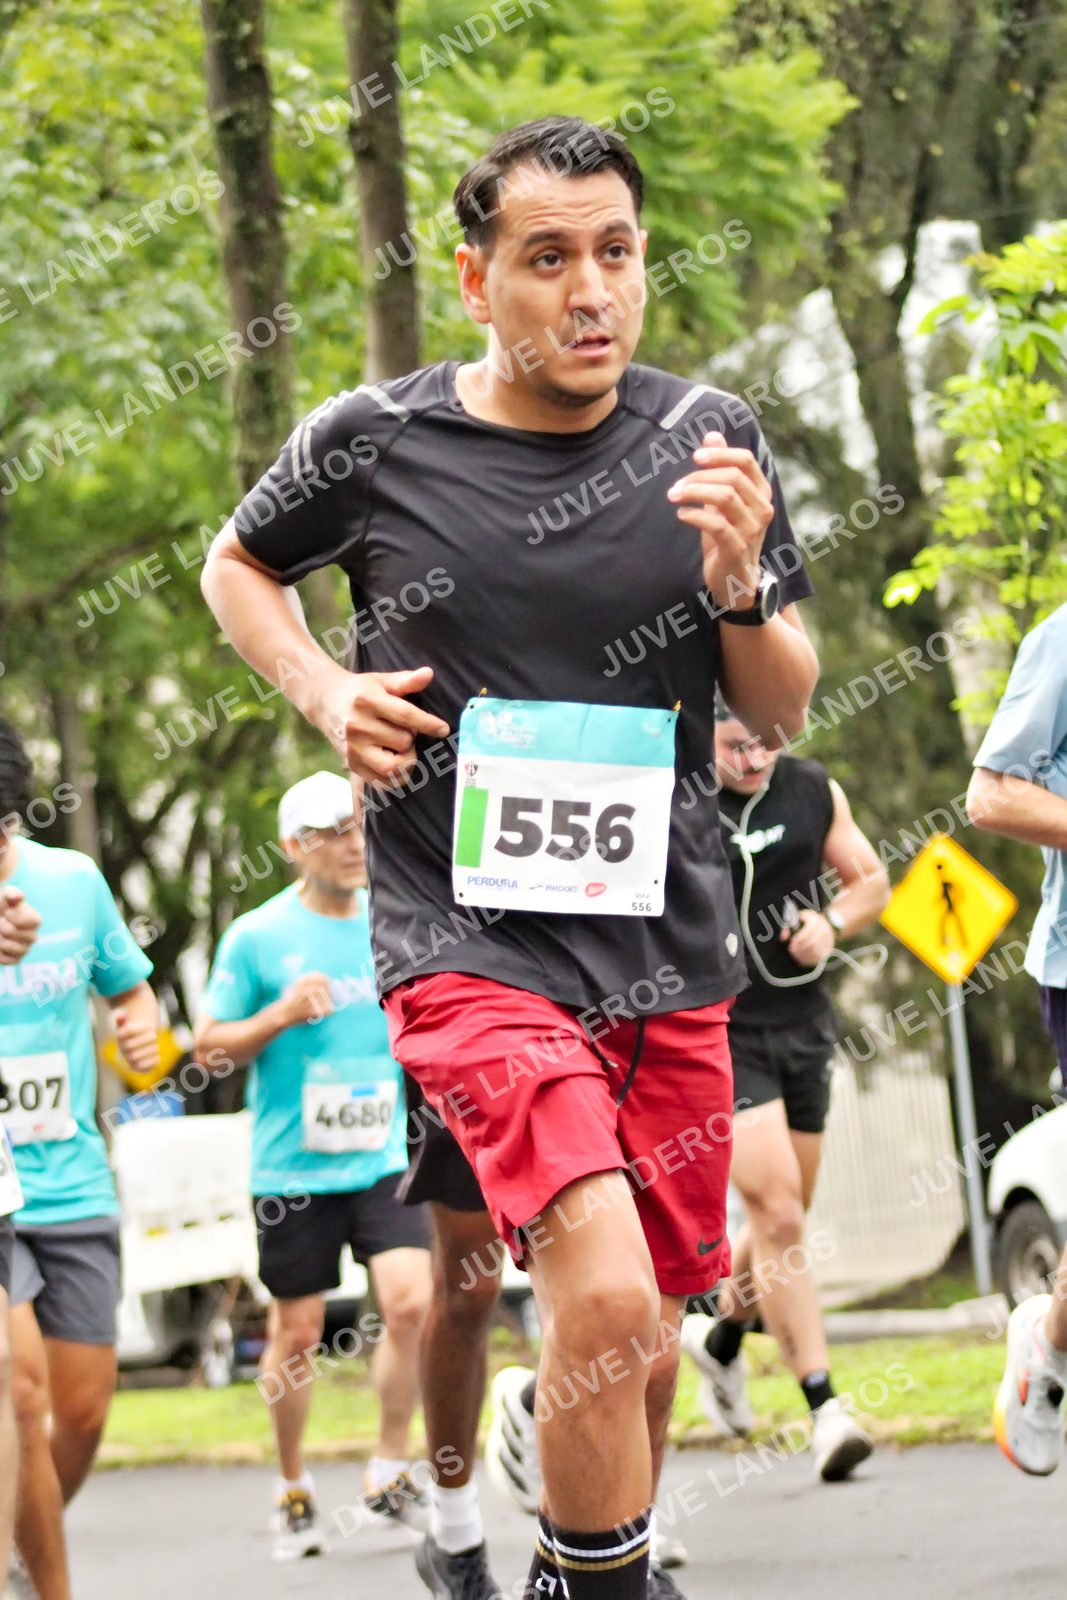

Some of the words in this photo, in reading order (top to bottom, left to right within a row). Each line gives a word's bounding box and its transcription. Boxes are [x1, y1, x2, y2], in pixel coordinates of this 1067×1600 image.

[494, 796, 637, 864] 556
[467, 875, 519, 889] PERDURA
[631, 901, 652, 912] 556
[315, 1100, 391, 1129] 4680
